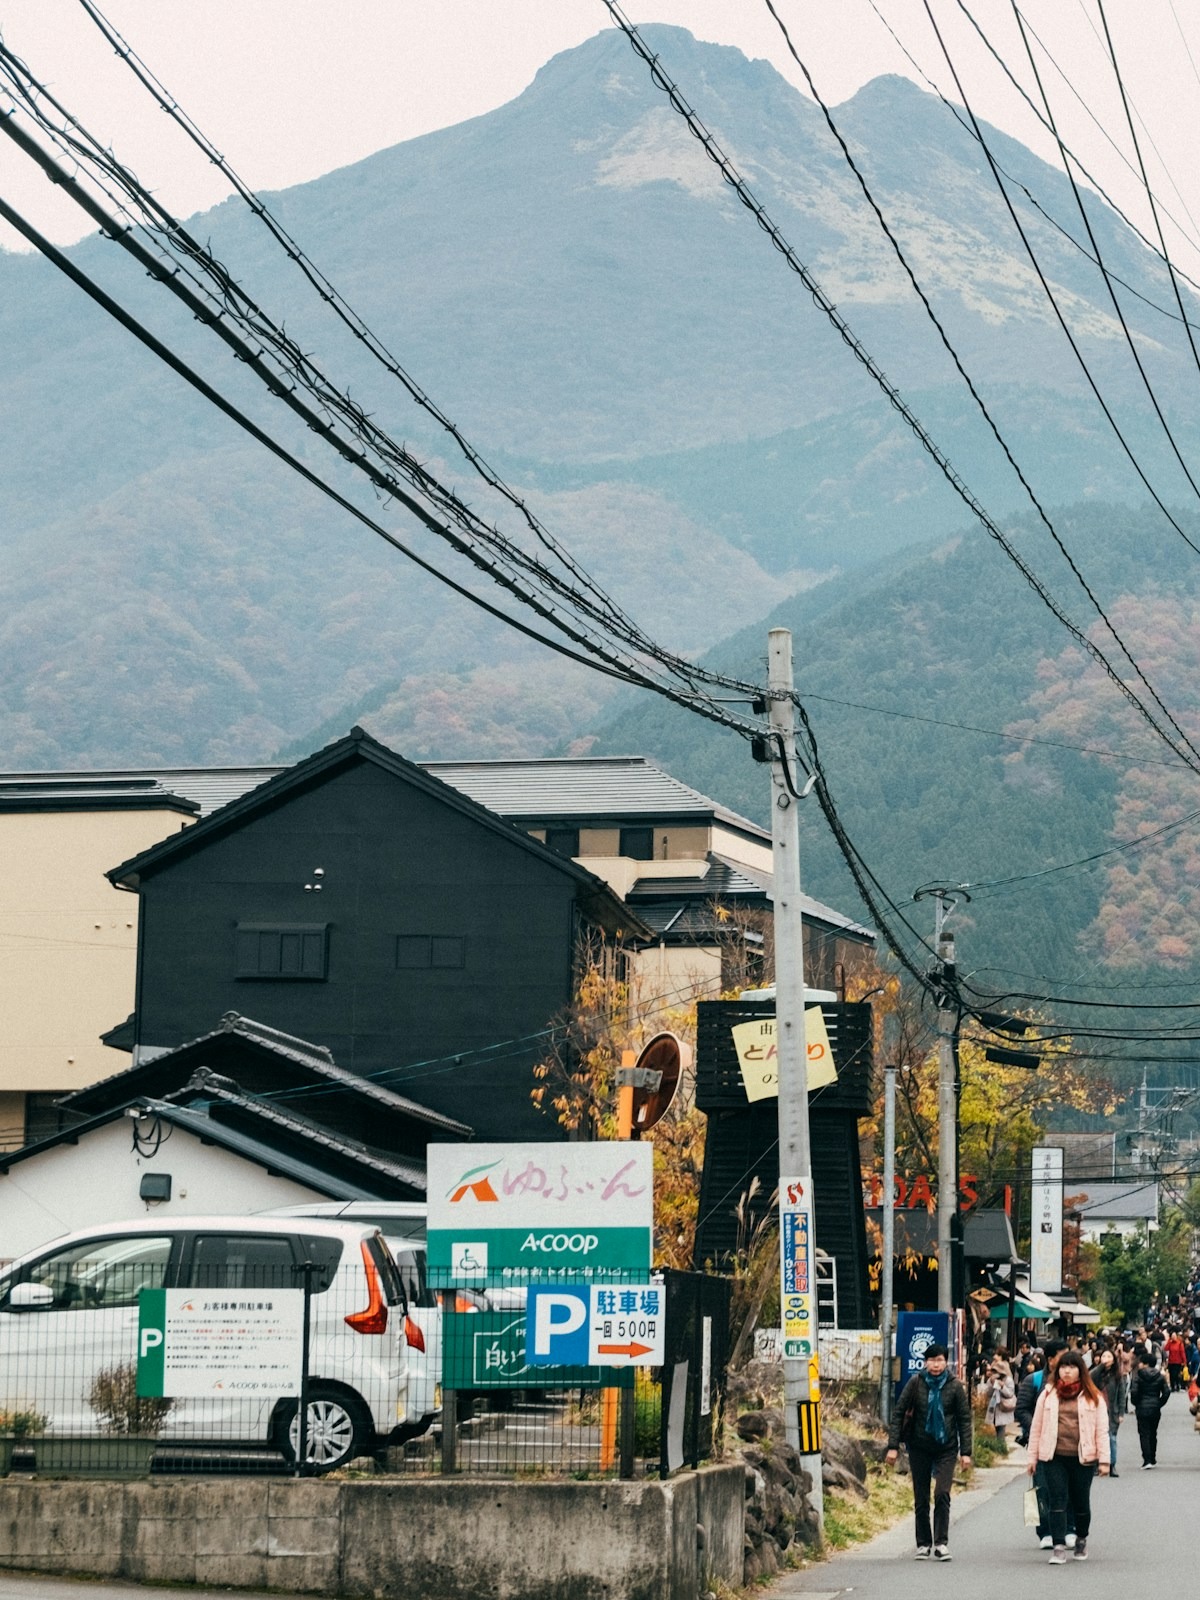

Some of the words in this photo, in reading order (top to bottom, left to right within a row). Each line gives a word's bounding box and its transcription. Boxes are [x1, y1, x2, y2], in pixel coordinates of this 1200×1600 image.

[743, 1044, 825, 1061] どんり
[502, 1159, 647, 1201] ゆふいん
[203, 1302, 273, 1311] お客様専用駐車場
[596, 1290, 659, 1316] 駐車場
[534, 1293, 587, 1356] P
[618, 1321, 656, 1339] 500円
[141, 1328, 163, 1358] P
[911, 1332, 935, 1341] COFFEE
[788, 1345, 807, 1355] 川上
[908, 1359, 924, 1370] BO
